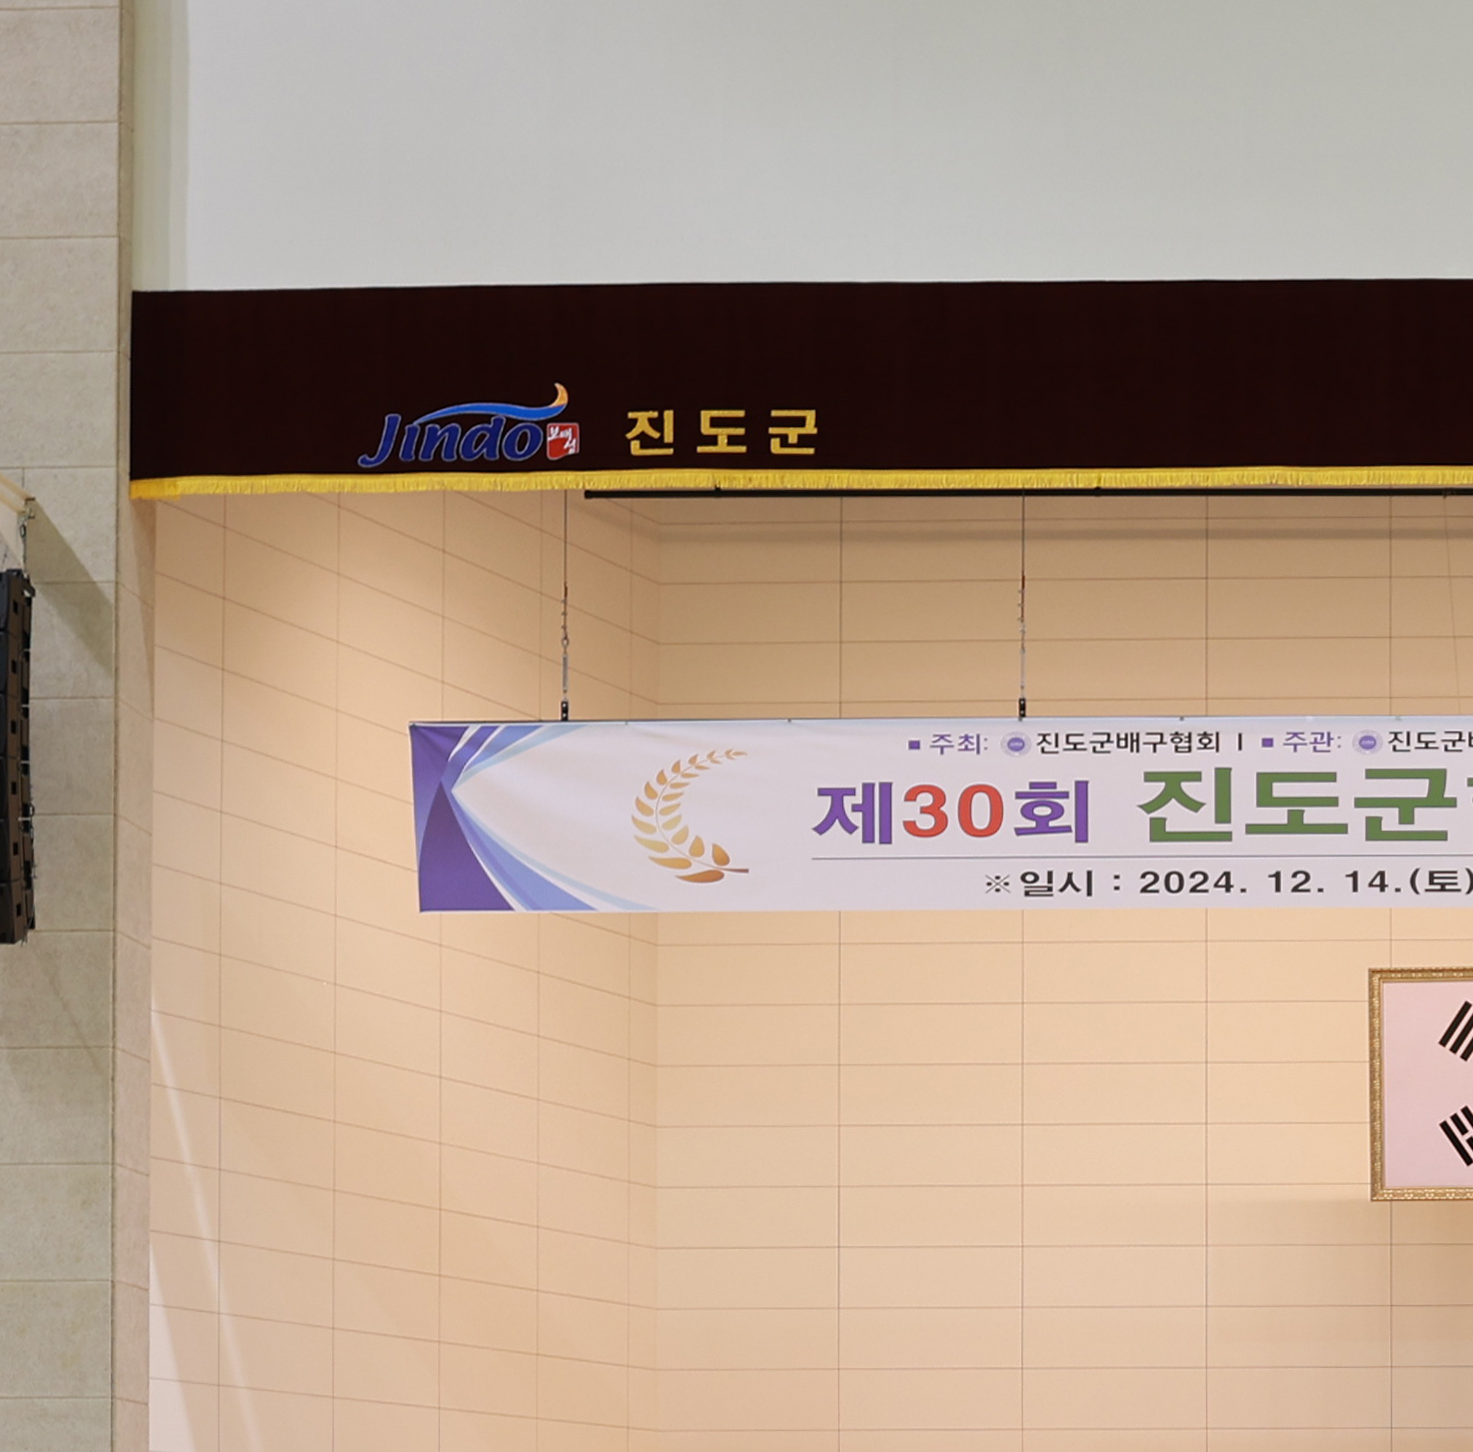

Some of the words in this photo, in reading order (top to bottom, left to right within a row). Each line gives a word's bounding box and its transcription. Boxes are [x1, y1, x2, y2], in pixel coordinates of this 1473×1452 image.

[357, 411, 544, 468] Jindo
[625, 409, 818, 456] 진도군
[1035, 730, 1221, 755] 진도군배구협회
[811, 778, 1090, 846] 제30회
[1139, 870, 1248, 895] 2024.
[1267, 870, 1325, 894] 12.
